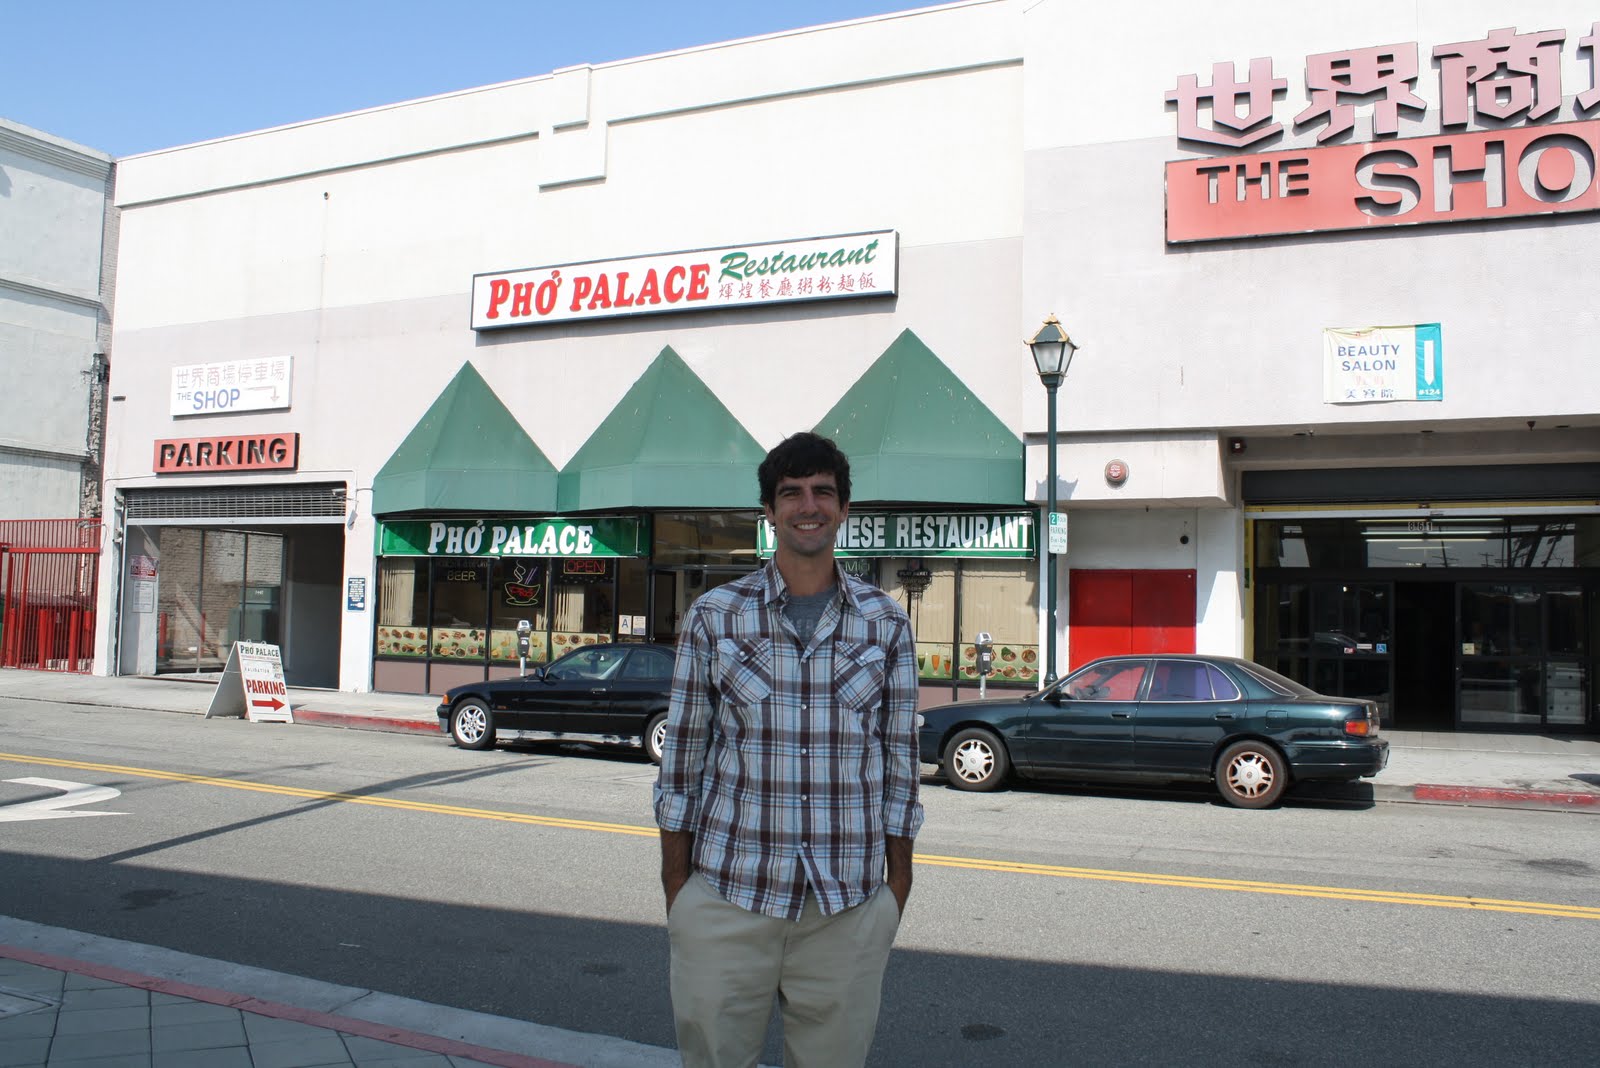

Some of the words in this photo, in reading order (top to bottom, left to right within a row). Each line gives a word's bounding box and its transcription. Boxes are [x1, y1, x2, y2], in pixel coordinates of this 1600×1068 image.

[1164, 22, 1600, 148] 世界商
[1196, 158, 1309, 203] THE
[569, 263, 710, 312] PALACE
[718, 239, 879, 283] Restaurant
[1337, 344, 1400, 357] BEAUTY
[176, 360, 285, 389] 世界商場停車場
[1342, 359, 1396, 372] SALON
[177, 391, 192, 401] THE
[193, 388, 241, 411] SHOP
[160, 437, 288, 468] PARKING
[489, 525, 593, 555] PALACE
[895, 515, 1032, 549] RESTAURANT
[447, 570, 476, 581] BEER
[566, 559, 604, 573] OPEN
[622, 618, 629, 628] A
[255, 647, 280, 658] PALACE
[246, 679, 286, 696] PARKING
